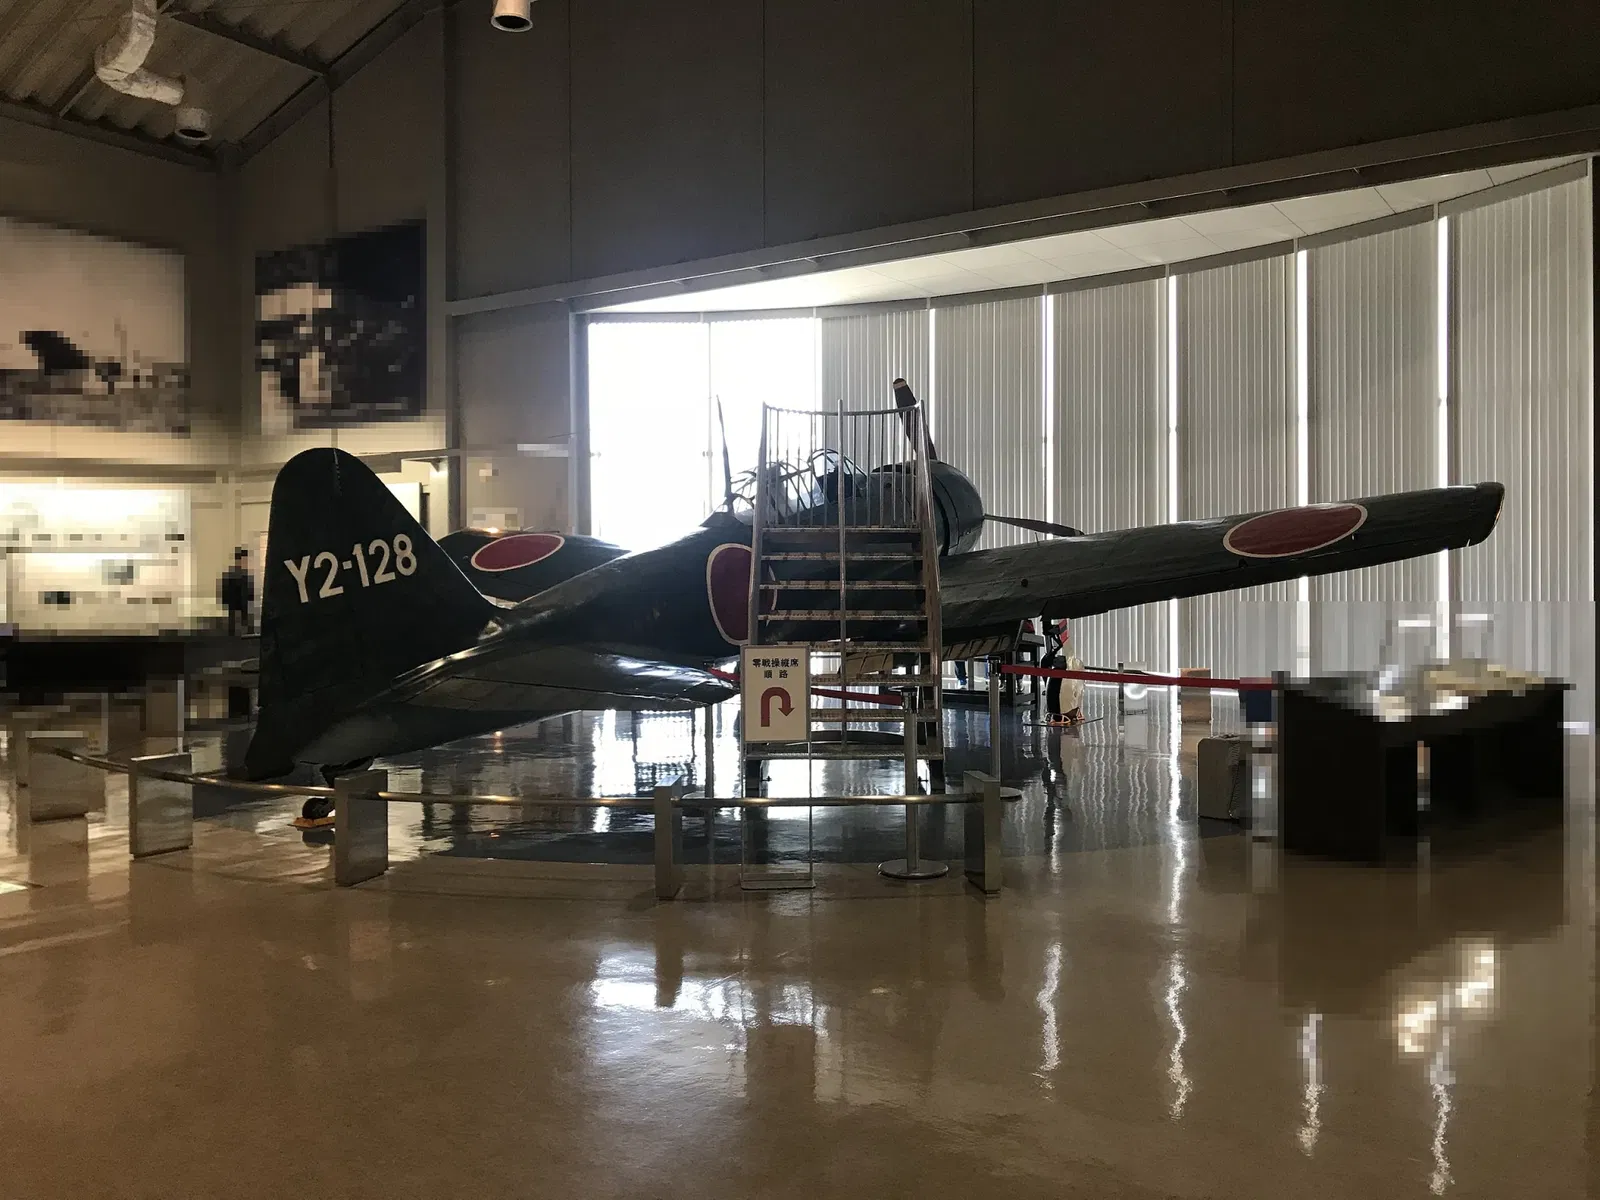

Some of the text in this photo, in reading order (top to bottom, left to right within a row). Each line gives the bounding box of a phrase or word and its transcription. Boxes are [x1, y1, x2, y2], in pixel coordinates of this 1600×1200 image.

[283, 533, 417, 604] Y2-128
[752, 658, 799, 668] 零戦操縦席
